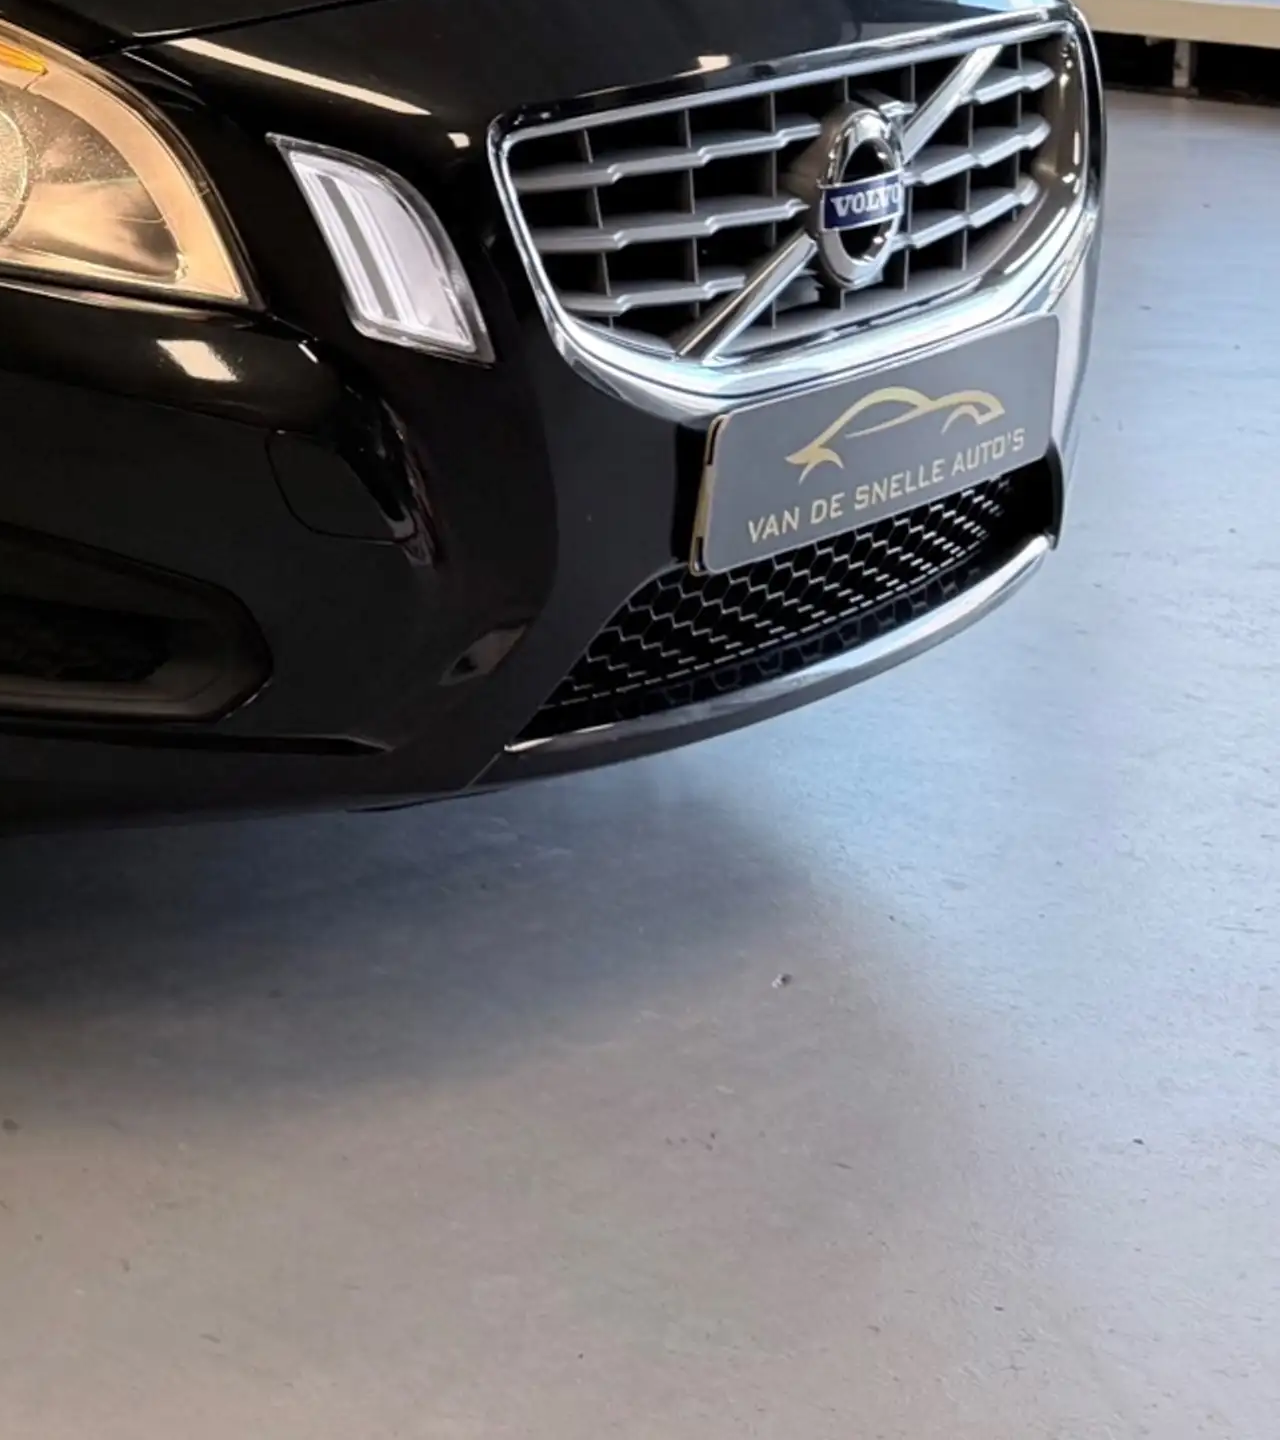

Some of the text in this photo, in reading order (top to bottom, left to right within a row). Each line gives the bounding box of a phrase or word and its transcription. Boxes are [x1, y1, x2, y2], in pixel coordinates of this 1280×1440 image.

[829, 182, 902, 218] VOLVO
[747, 427, 1026, 544] VAN DE SNELLE AUTO'S
